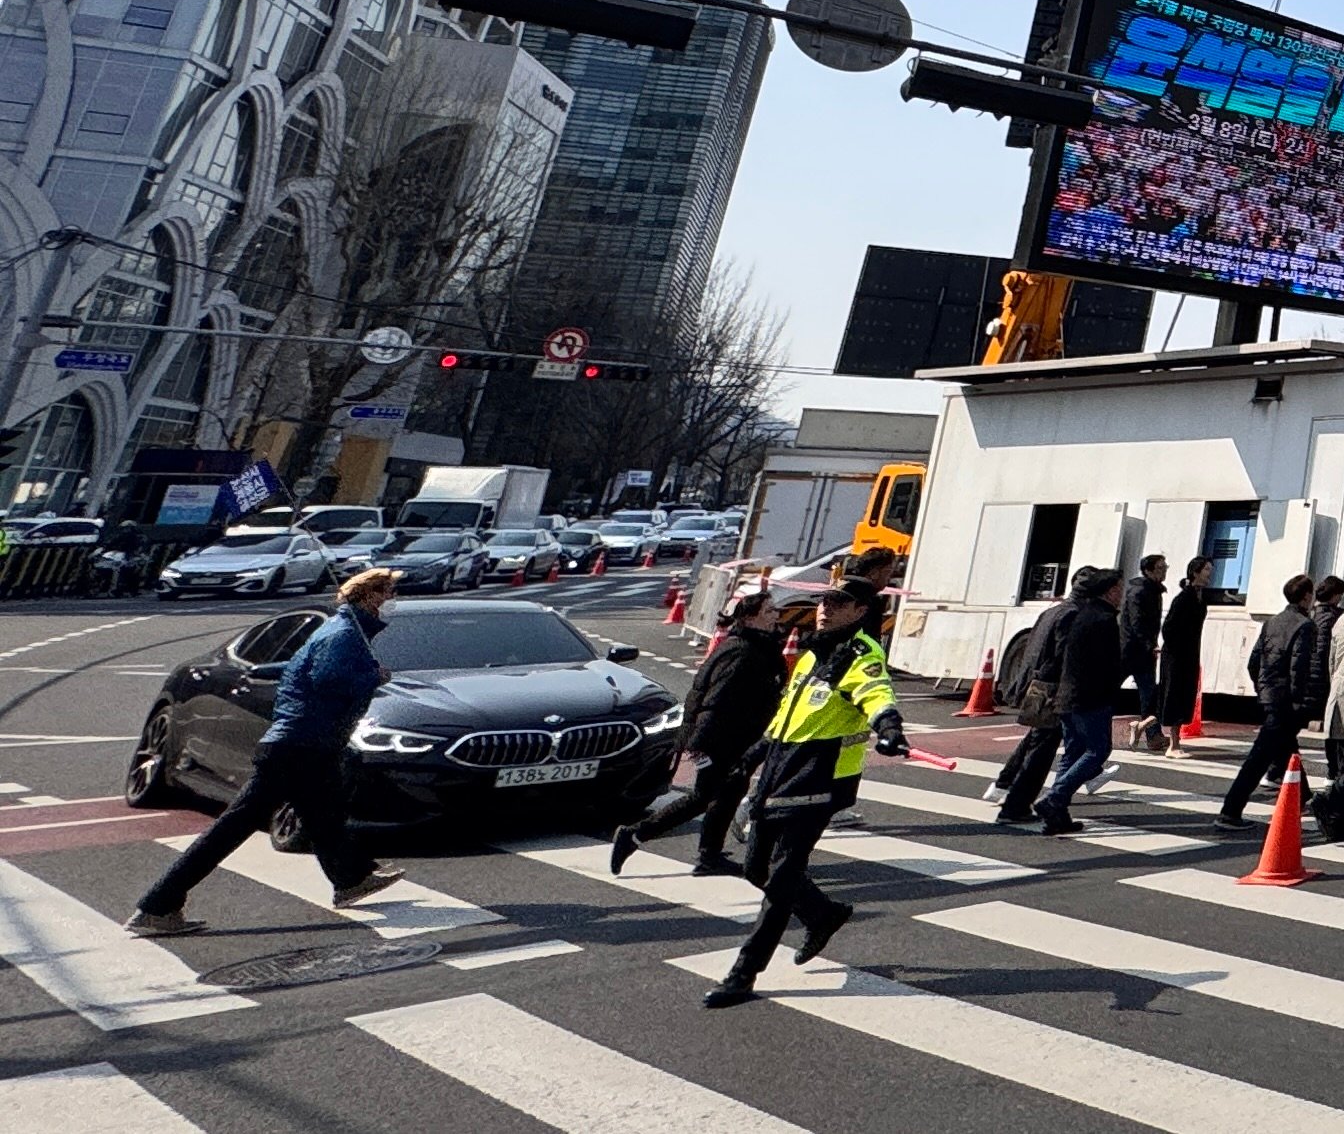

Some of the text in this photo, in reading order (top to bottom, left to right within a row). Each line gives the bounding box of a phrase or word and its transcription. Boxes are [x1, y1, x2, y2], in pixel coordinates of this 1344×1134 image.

[1101, 13, 1334, 125] 윤석열을
[1187, 113, 1217, 137] 3월
[1219, 121, 1249, 145] 8일
[1250, 128, 1278, 153] (토)
[1285, 137, 1314, 159] 2시
[550, 764, 593, 781] 2013
